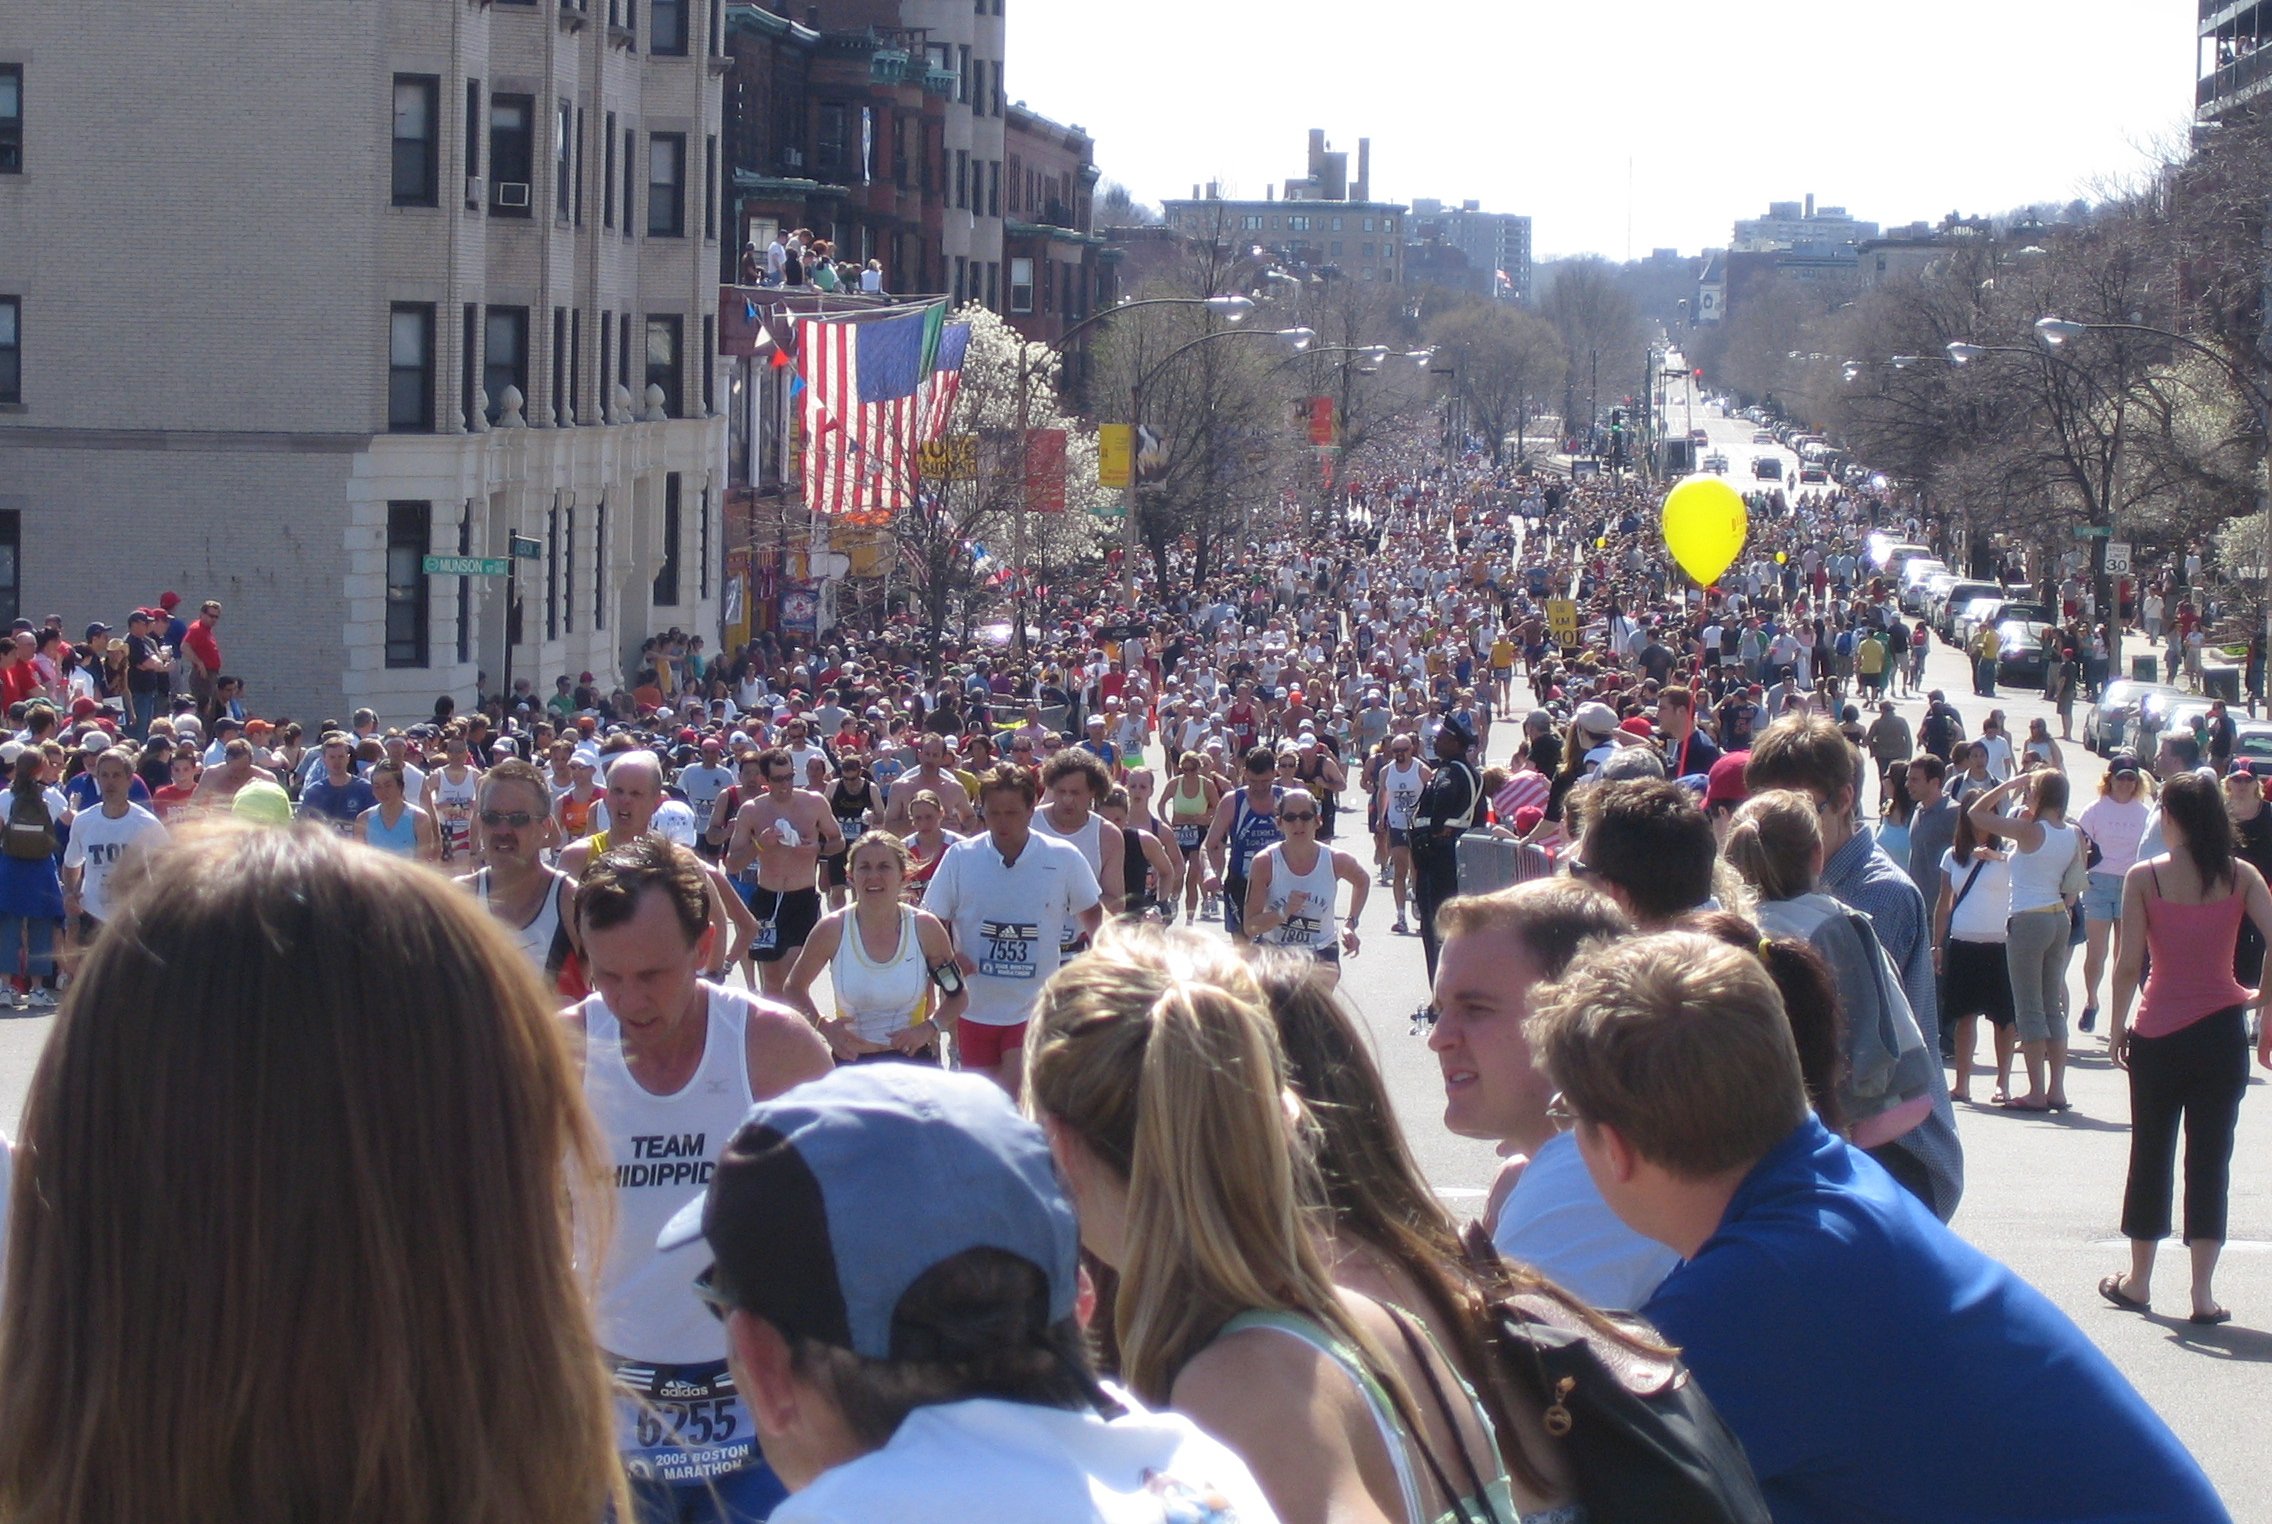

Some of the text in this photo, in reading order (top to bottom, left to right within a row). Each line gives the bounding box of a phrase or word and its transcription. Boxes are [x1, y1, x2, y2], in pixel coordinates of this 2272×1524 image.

[440, 560, 482, 573] MUNSON
[2106, 559, 2127, 572] 30
[1555, 617, 1570, 625] KM
[1552, 630, 1575, 645] 40
[1281, 928, 1311, 943] 7801
[989, 939, 1027, 962] 7553
[631, 1133, 705, 1159] TEAM
[660, 1386, 709, 1397] adidas
[637, 1398, 737, 1447] 6255
[655, 1444, 749, 1467] 2005 BOSTON
[663, 1459, 743, 1480] MARATHON
